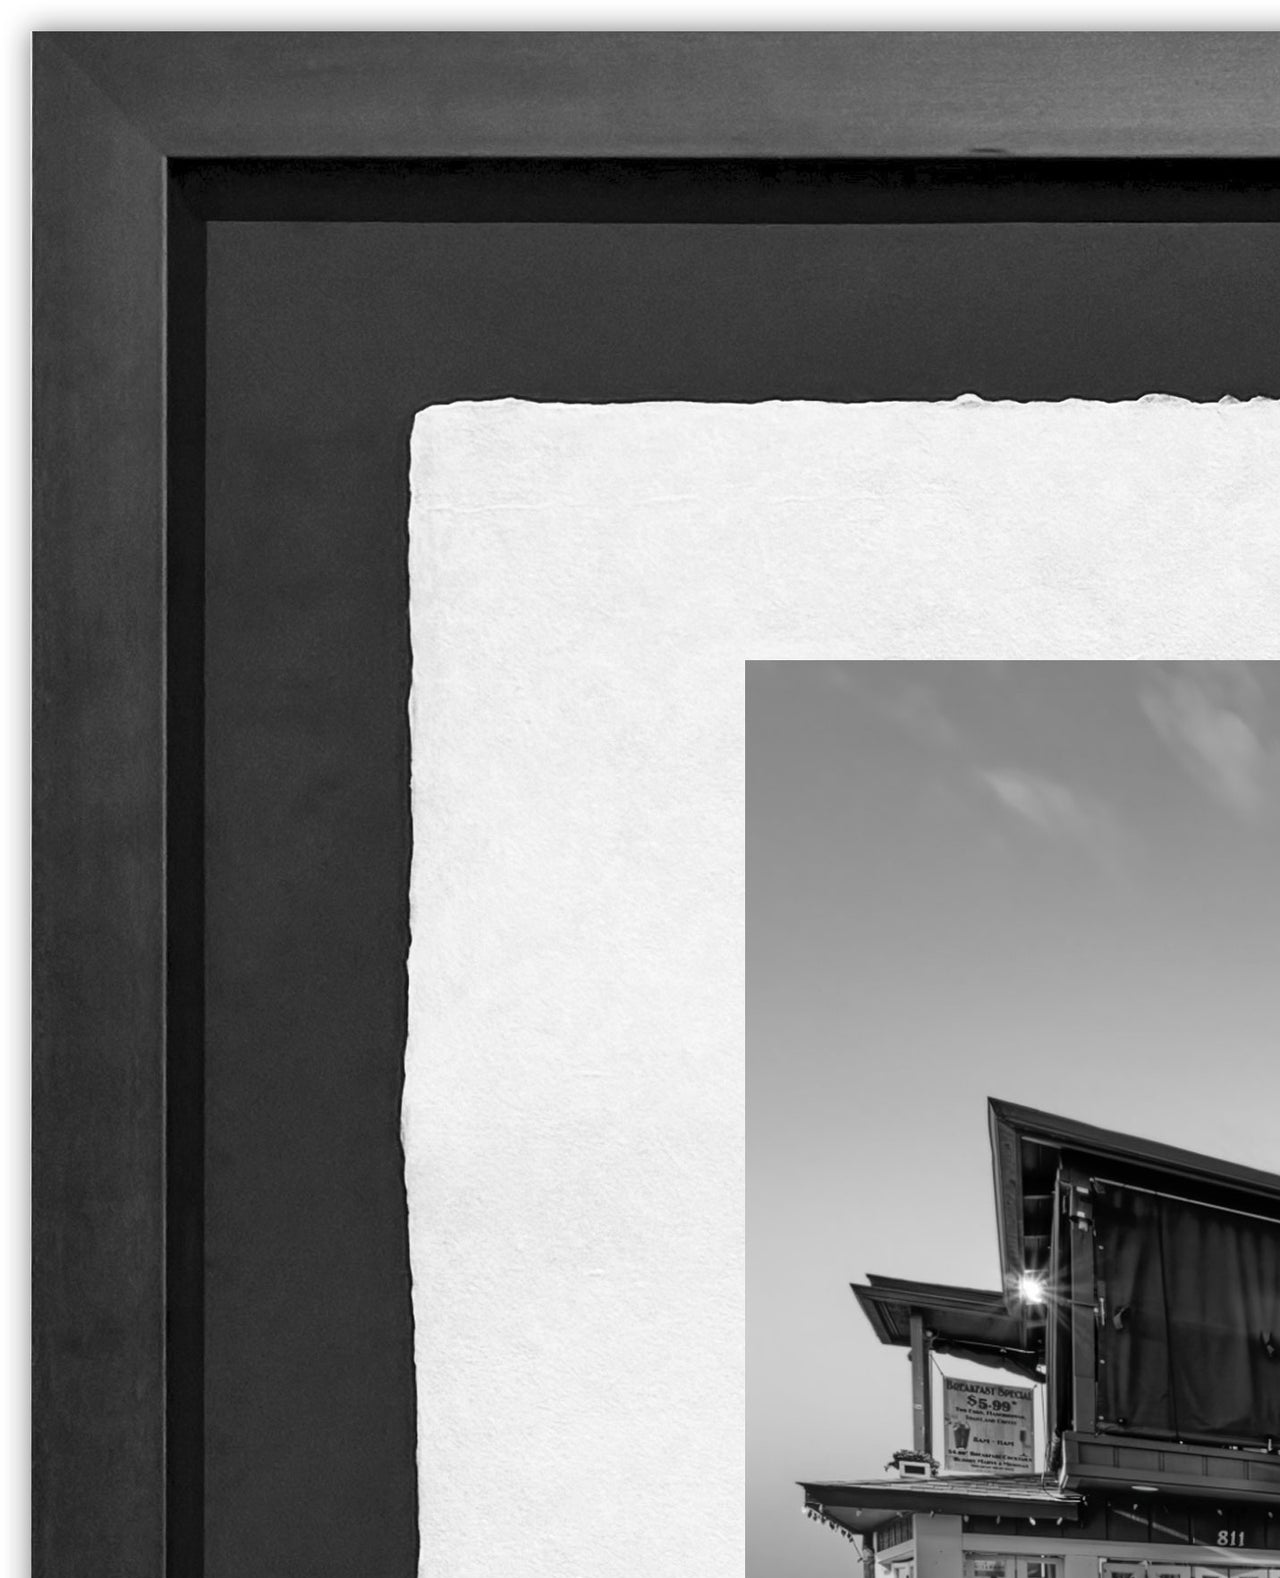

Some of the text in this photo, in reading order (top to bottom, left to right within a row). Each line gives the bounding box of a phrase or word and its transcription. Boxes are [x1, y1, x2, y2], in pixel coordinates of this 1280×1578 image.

[946, 1379, 1031, 1401] BREAKFAST SPECIAL
[1216, 1529, 1245, 1547] 811
